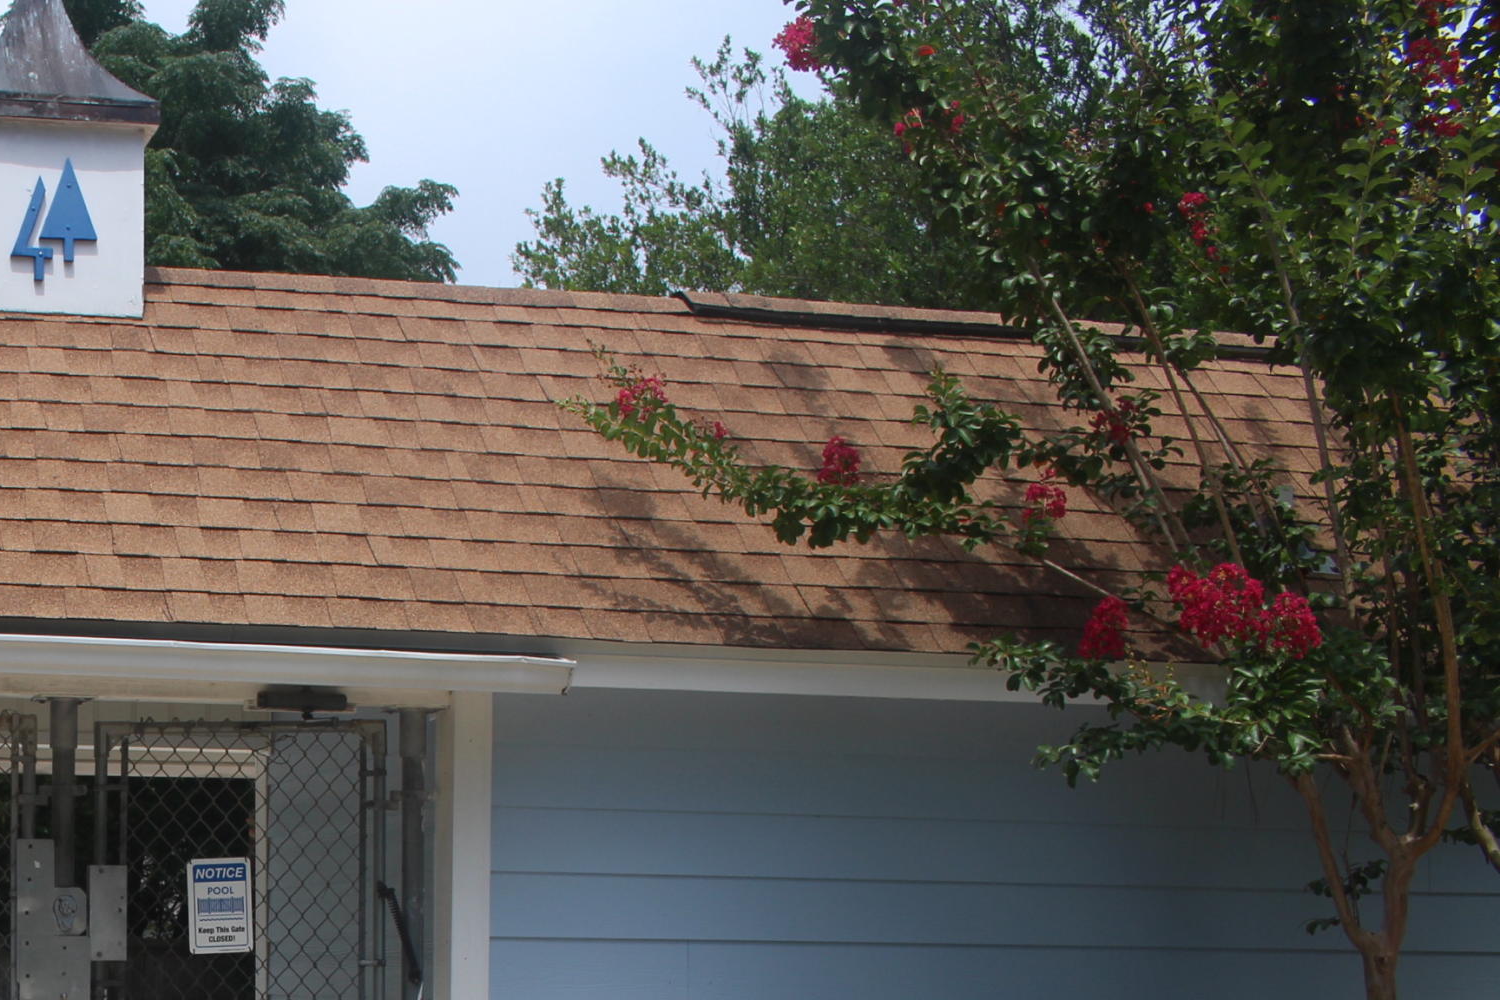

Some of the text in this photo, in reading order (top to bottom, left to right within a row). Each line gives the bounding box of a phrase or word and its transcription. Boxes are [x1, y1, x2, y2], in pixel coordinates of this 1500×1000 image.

[196, 867, 244, 880] NOTICE
[208, 886, 235, 895] POOL
[198, 926, 215, 934] Keep
[208, 935, 236, 943] CLOSED!
